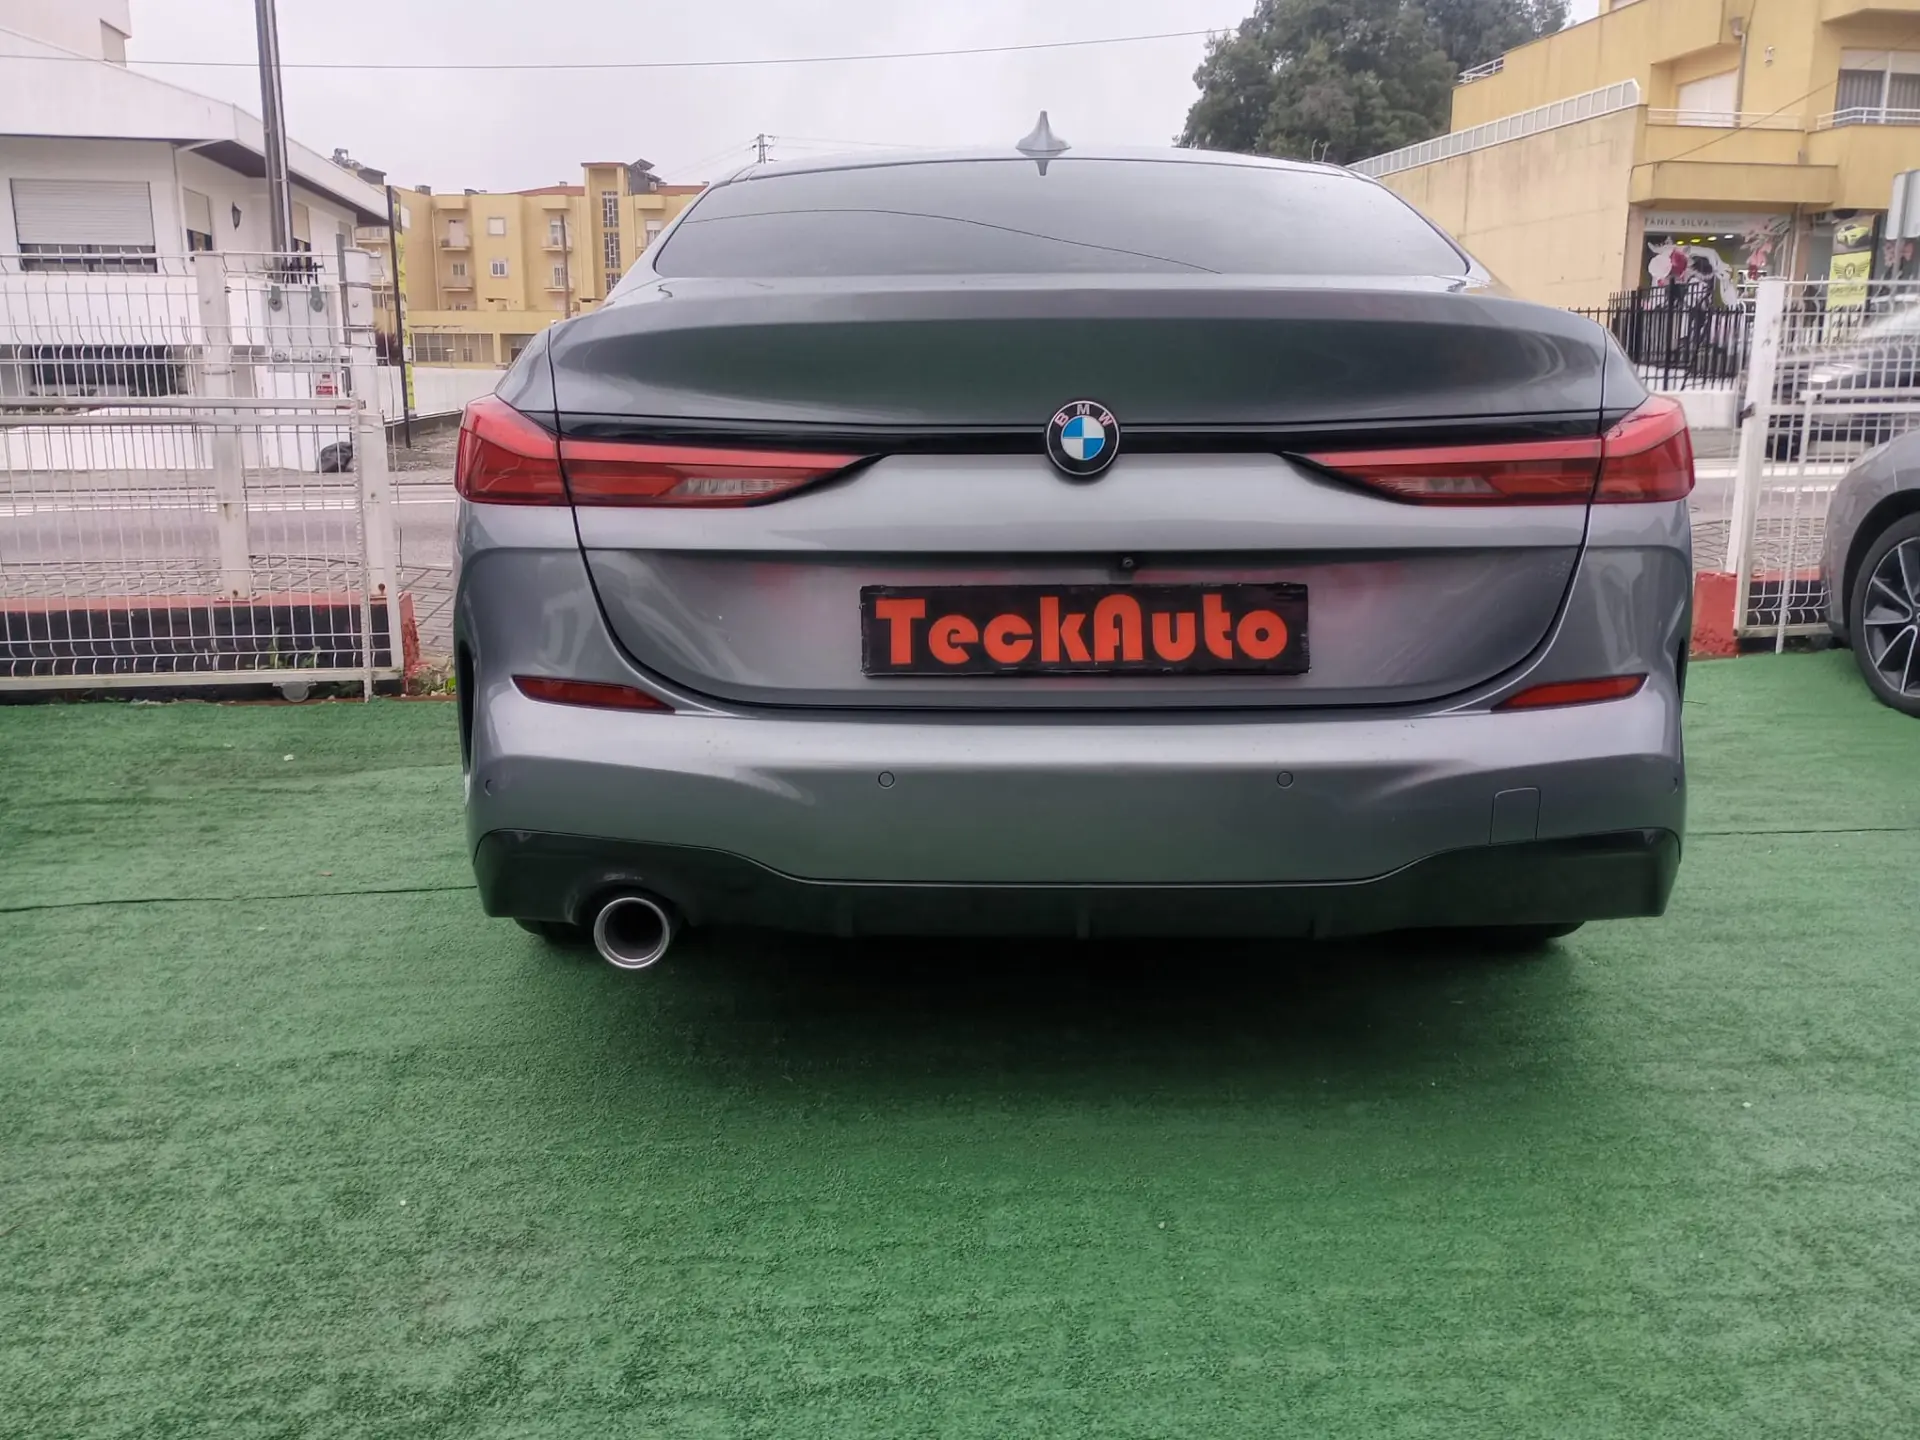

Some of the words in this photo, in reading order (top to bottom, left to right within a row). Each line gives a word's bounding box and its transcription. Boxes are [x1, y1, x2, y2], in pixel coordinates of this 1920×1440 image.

[1680, 217, 1710, 227] SILVA
[1054, 403, 1113, 427] BMW
[875, 593, 1288, 665] TeckAuto
